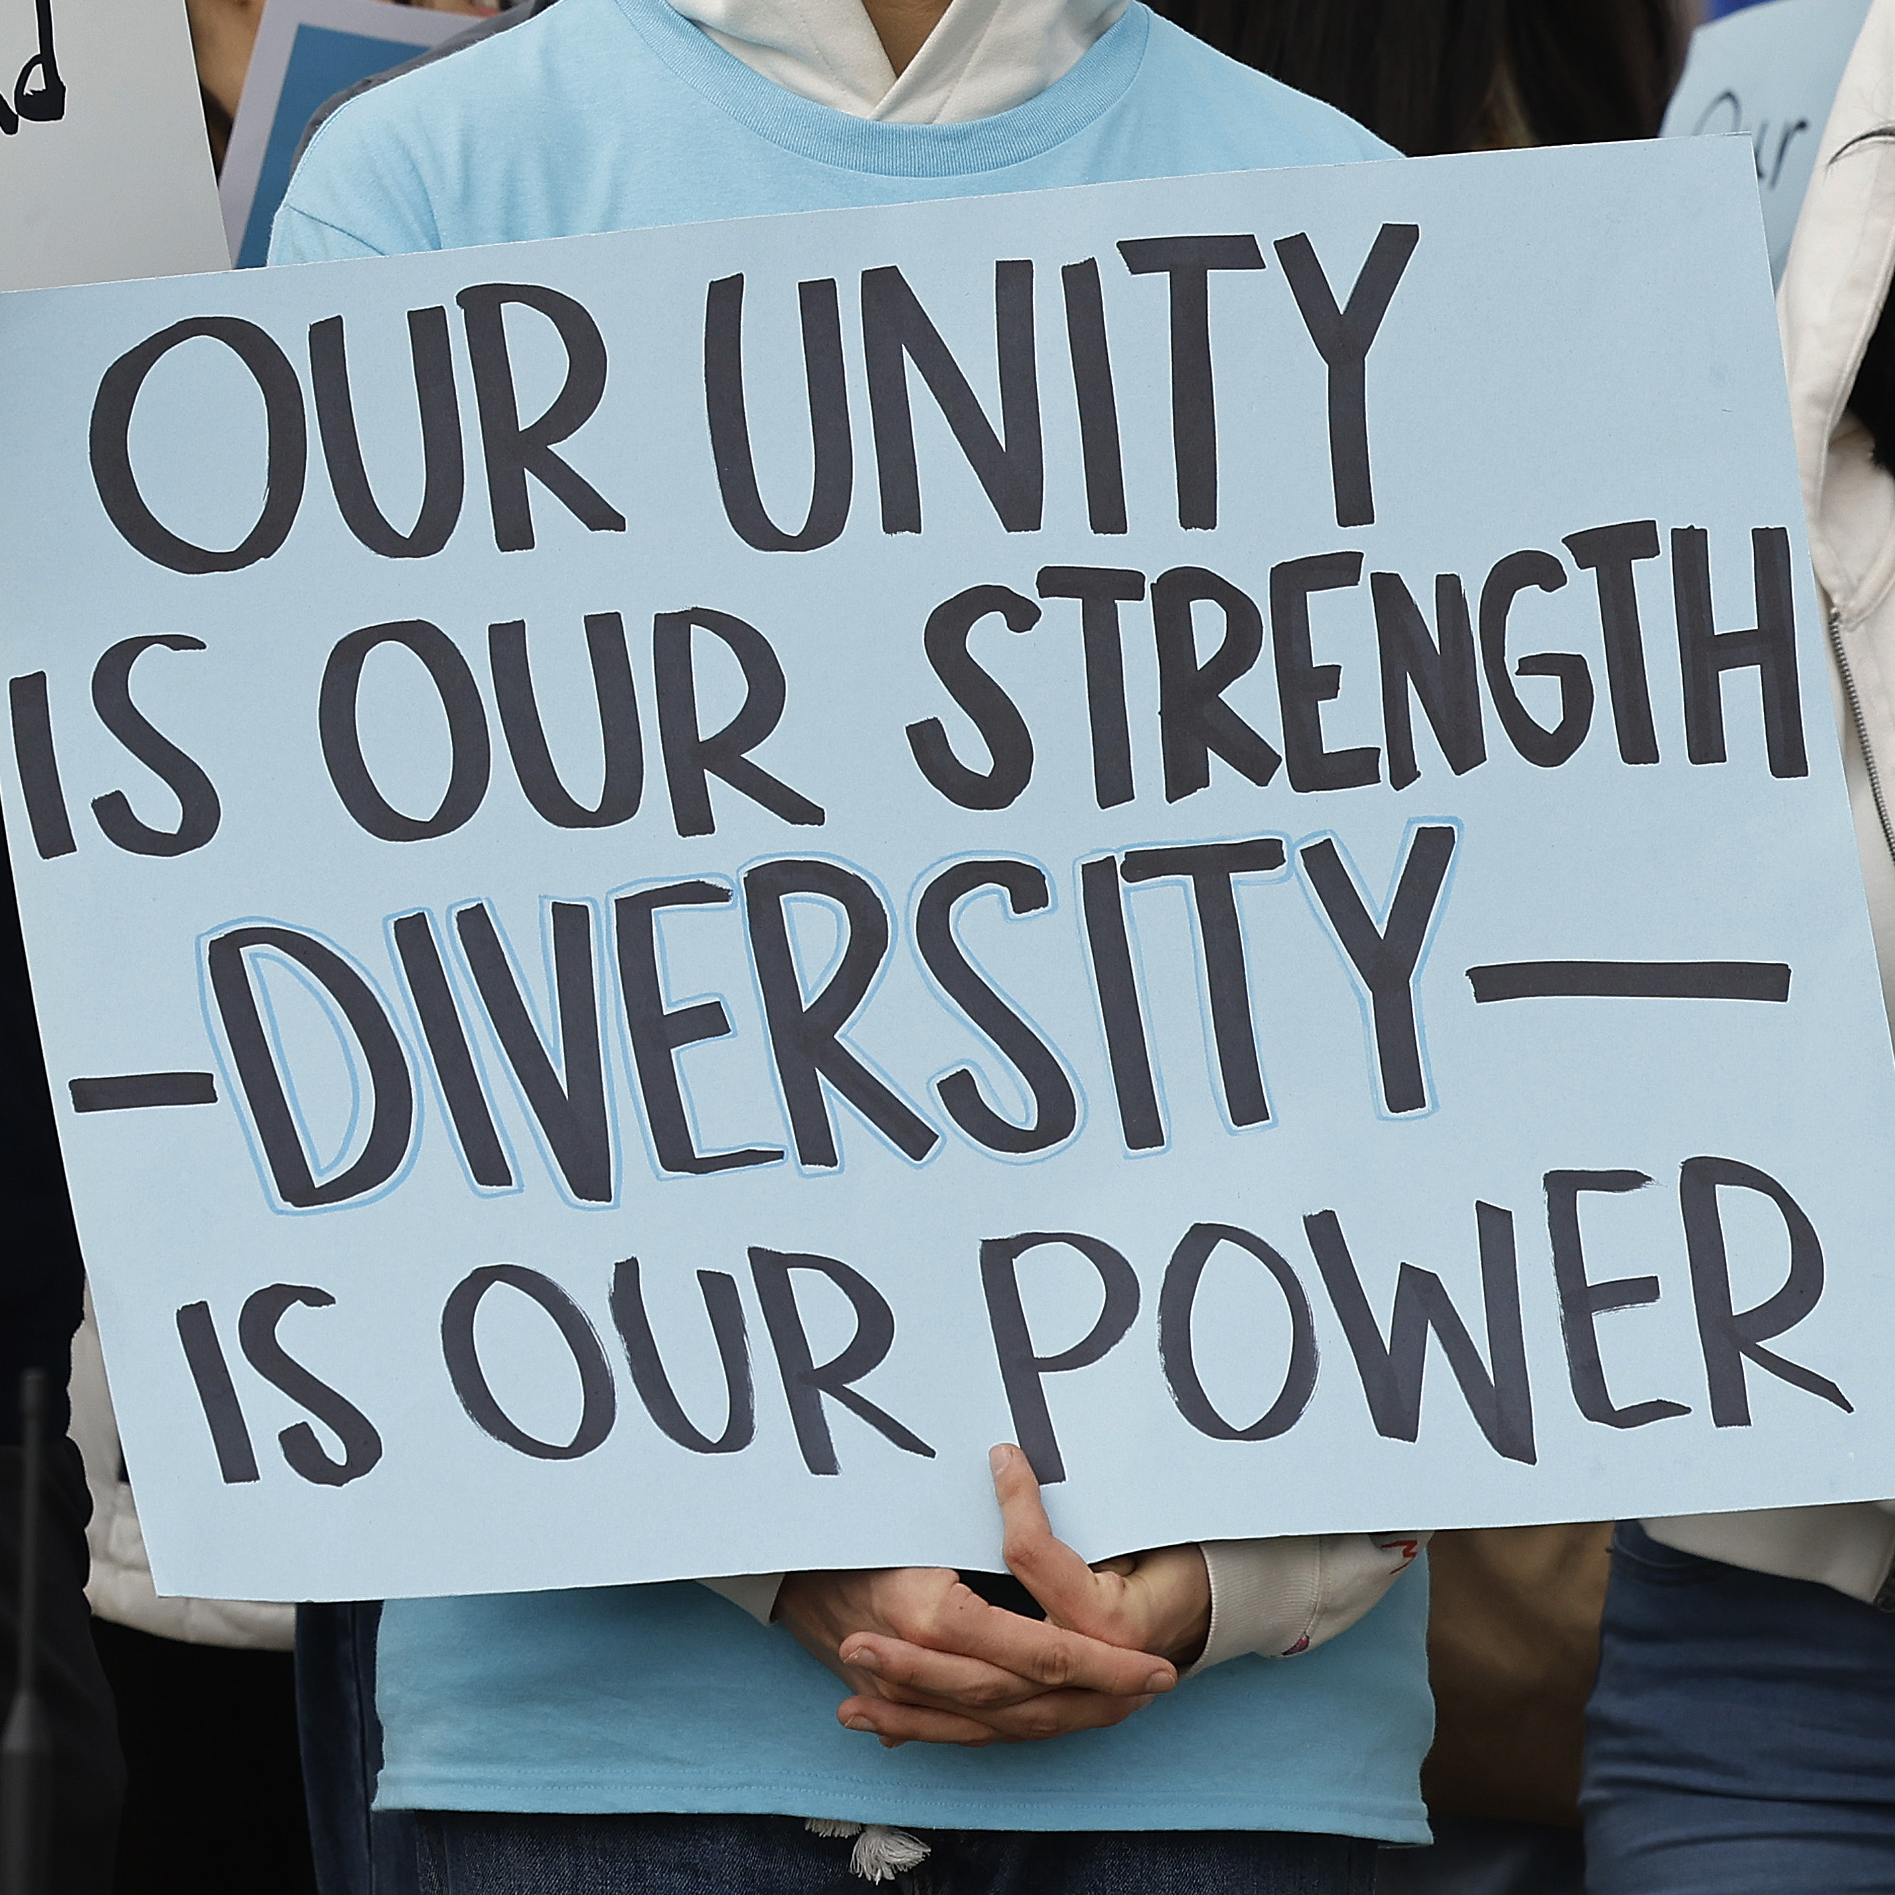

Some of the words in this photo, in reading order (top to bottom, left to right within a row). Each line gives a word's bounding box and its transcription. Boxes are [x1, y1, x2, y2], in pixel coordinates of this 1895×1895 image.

[88, 282, 627, 575] OUR
[704, 222, 1420, 553] UNITY
[8, 633, 221, 860] IS
[318, 606, 826, 843] OUR
[905, 519, 1809, 811] STRENGTH
[175, 1283, 383, 1488] IS
[440, 1246, 937, 1476] OUR
[979, 1155, 1854, 1485] POWER
